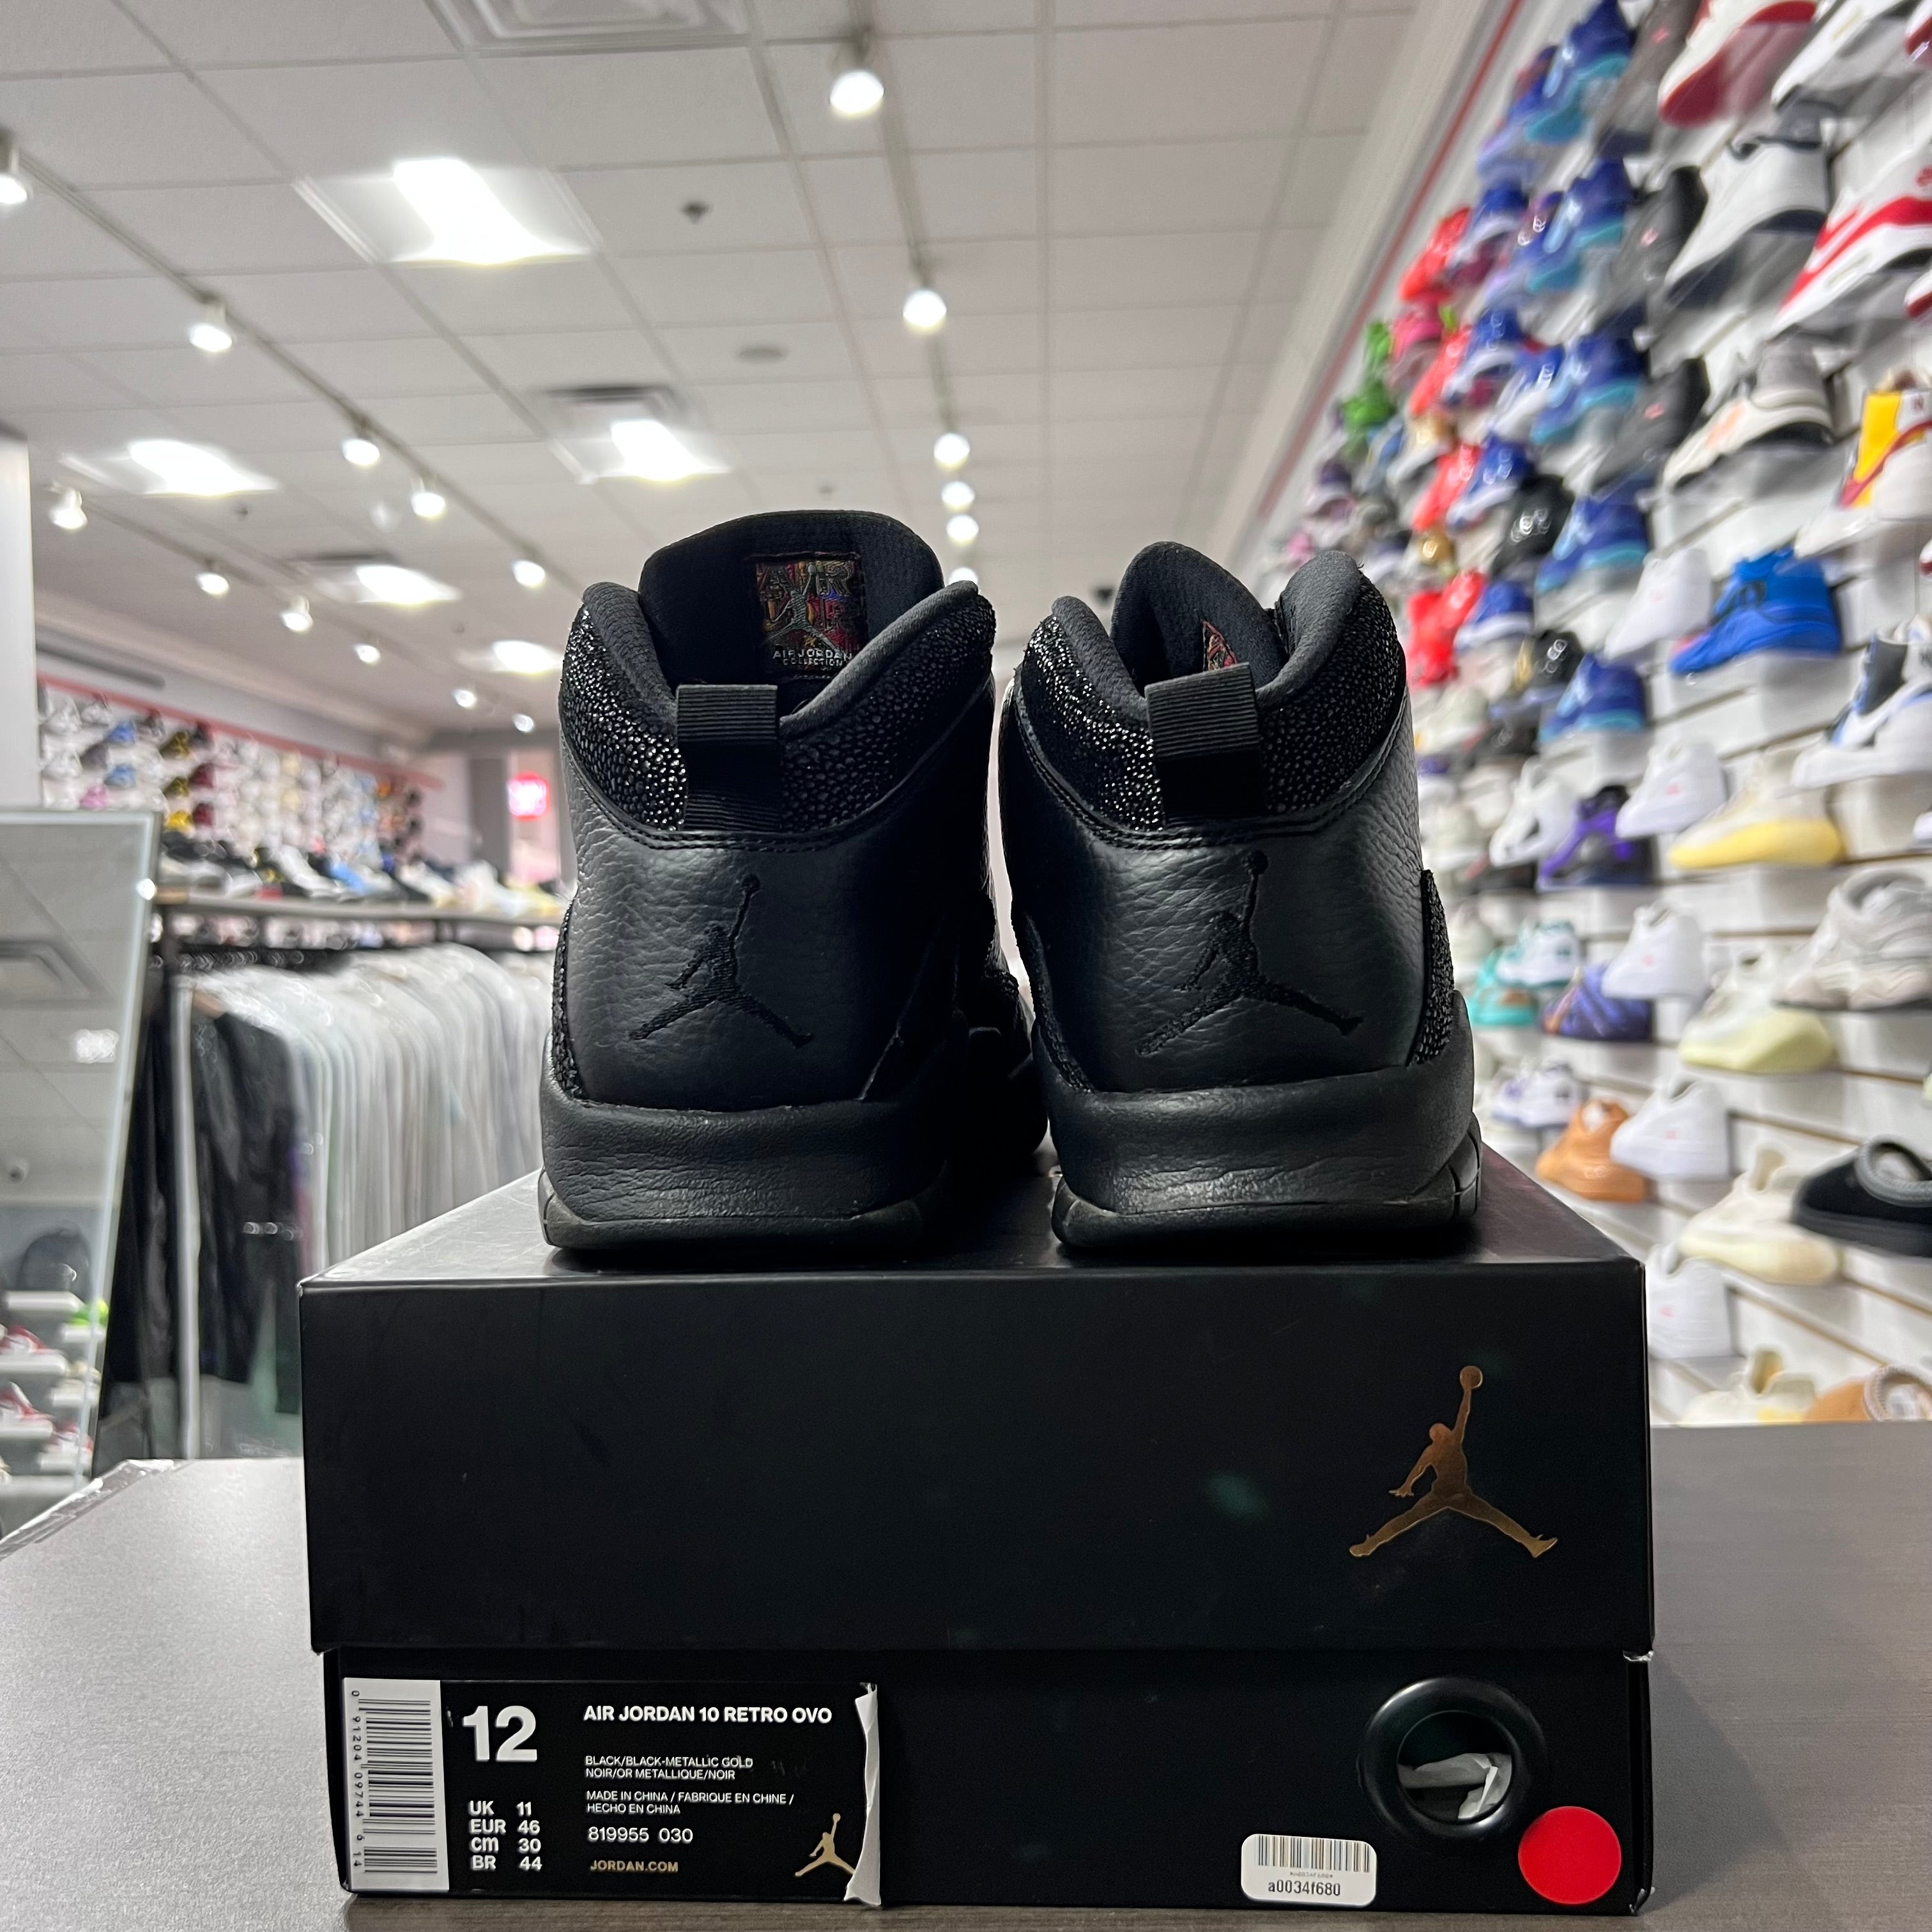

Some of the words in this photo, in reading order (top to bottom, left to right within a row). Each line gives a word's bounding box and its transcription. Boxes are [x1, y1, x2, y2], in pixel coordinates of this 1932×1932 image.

[584, 1706, 614, 1721] AIR
[619, 1706, 694, 1721] JORDAN
[700, 1707, 719, 1722] 10
[724, 1707, 787, 1722] RETRO
[792, 1708, 832, 1723] OVO
[353, 1717, 362, 1760] 91204
[463, 1706, 537, 1761] 12
[586, 1756, 719, 1768] BLACK/BLACK-METALLIC
[722, 1757, 753, 1768] GOLD
[586, 1768, 632, 1779] NOIR/OR
[636, 1769, 735, 1780] METALLIQUE/NOIR
[355, 1773, 364, 1817] 09744
[587, 1791, 618, 1801] MADE
[621, 1791, 631, 1800] IN
[634, 1791, 668, 1801] CHINA
[671, 1791, 675, 1802] /
[678, 1792, 732, 1803] FABRIQUE
[735, 1793, 749, 1803] EN
[753, 1793, 786, 1804] CHINE
[789, 1794, 793, 1804] /
[469, 1800, 494, 1816] UK
[517, 1802, 531, 1816] 11
[587, 1803, 626, 1813] HECHO
[629, 1804, 643, 1814] EN
[647, 1804, 680, 1814] CHINA
[470, 1819, 506, 1834] EUR
[518, 1820, 540, 1835] 46
[588, 1827, 649, 1842] 819955
[659, 1828, 693, 1843] 030
[519, 1838, 541, 1853] 30
[471, 1855, 496, 1870] BR
[519, 1857, 542, 1871] 44
[591, 1860, 678, 1871] JORDAN.COM
[1268, 1880, 1340, 1896] a0034f680
